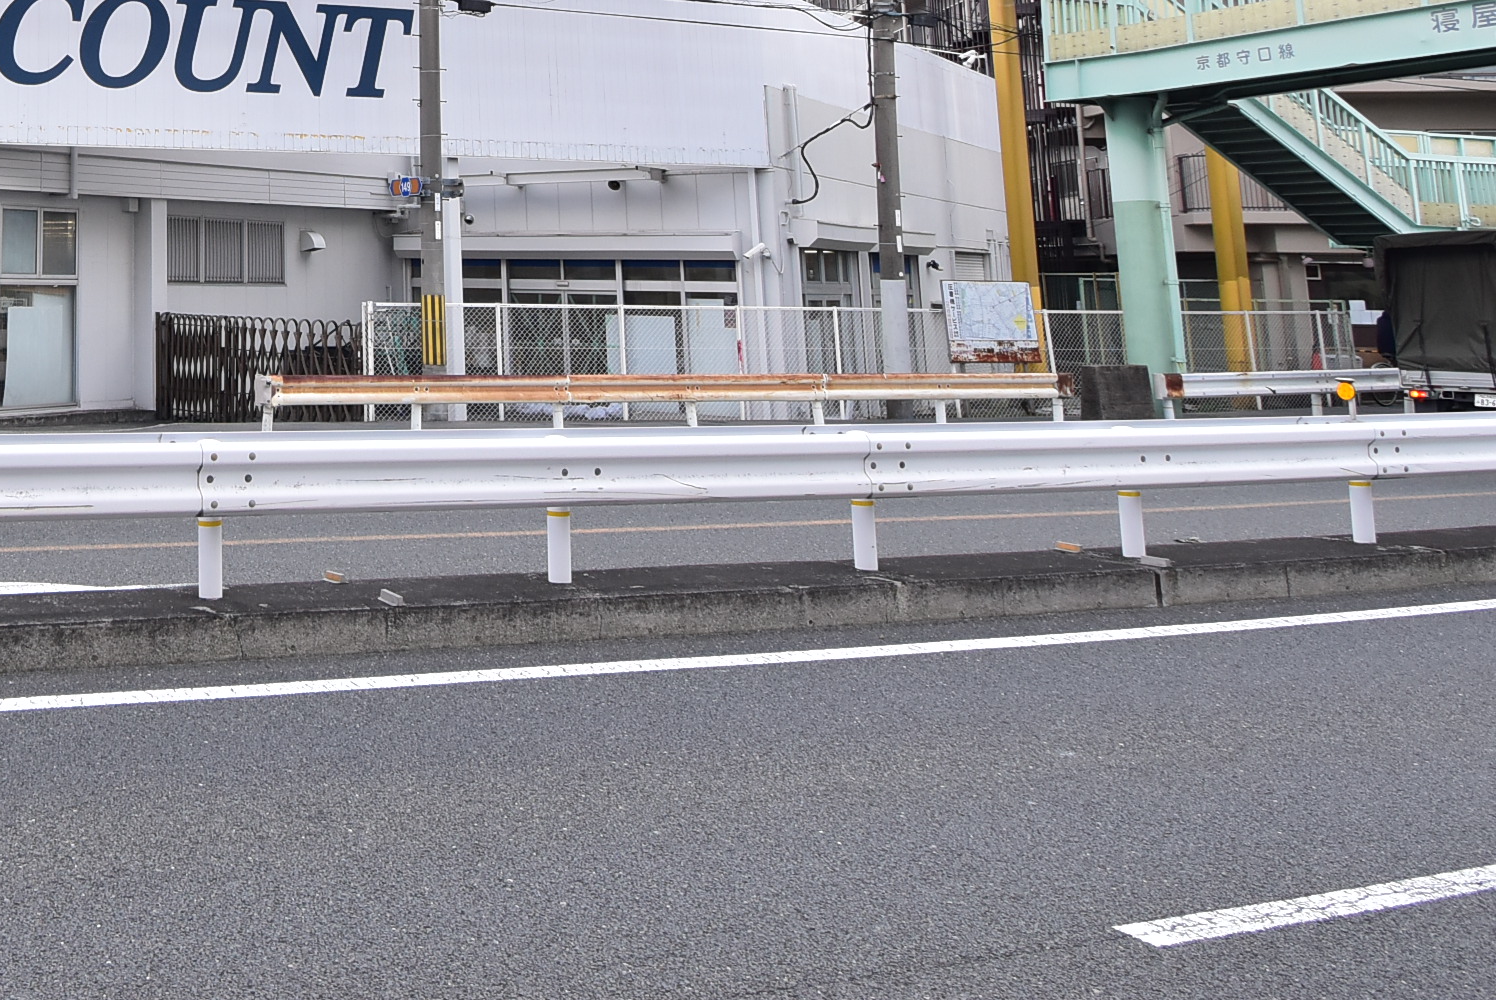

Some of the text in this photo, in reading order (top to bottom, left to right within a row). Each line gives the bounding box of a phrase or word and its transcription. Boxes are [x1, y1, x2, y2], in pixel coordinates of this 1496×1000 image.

[1195, 43, 1295, 71] 京都守口線
[401, 181, 411, 193] 149
